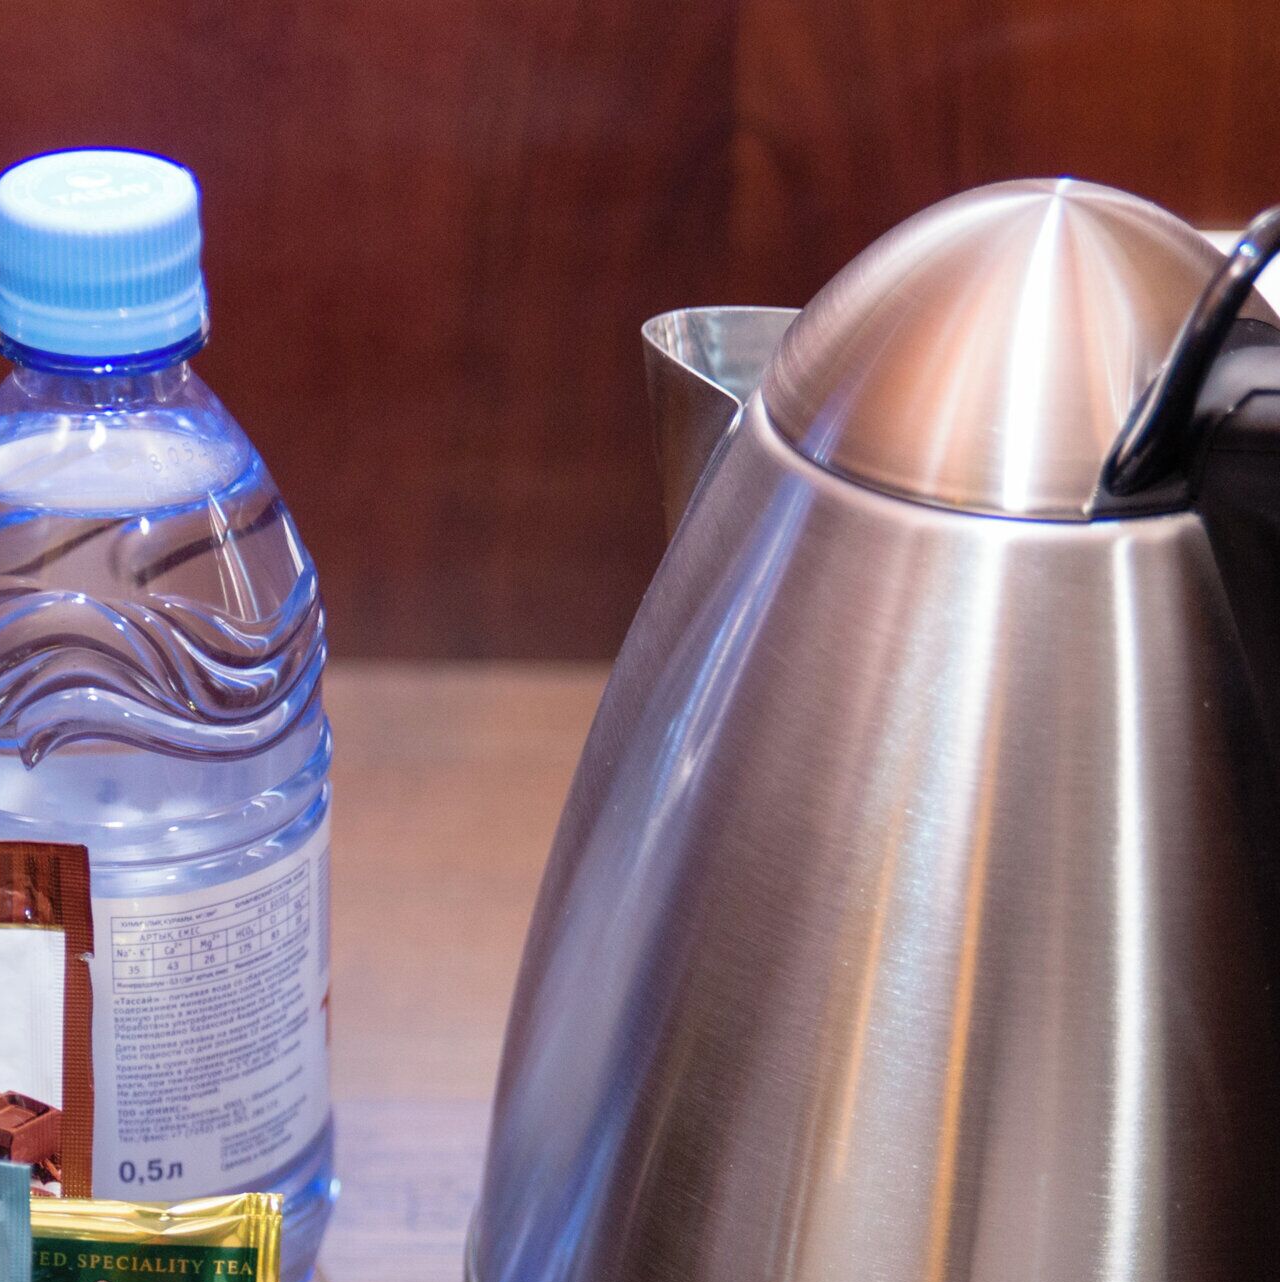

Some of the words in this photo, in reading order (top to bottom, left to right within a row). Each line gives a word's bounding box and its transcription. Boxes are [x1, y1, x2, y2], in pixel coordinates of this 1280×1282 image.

[128, 965, 141, 975] 35
[167, 961, 180, 971] 43
[77, 1253, 204, 1274] SPECIALITY
[213, 1259, 254, 1275] TEA
